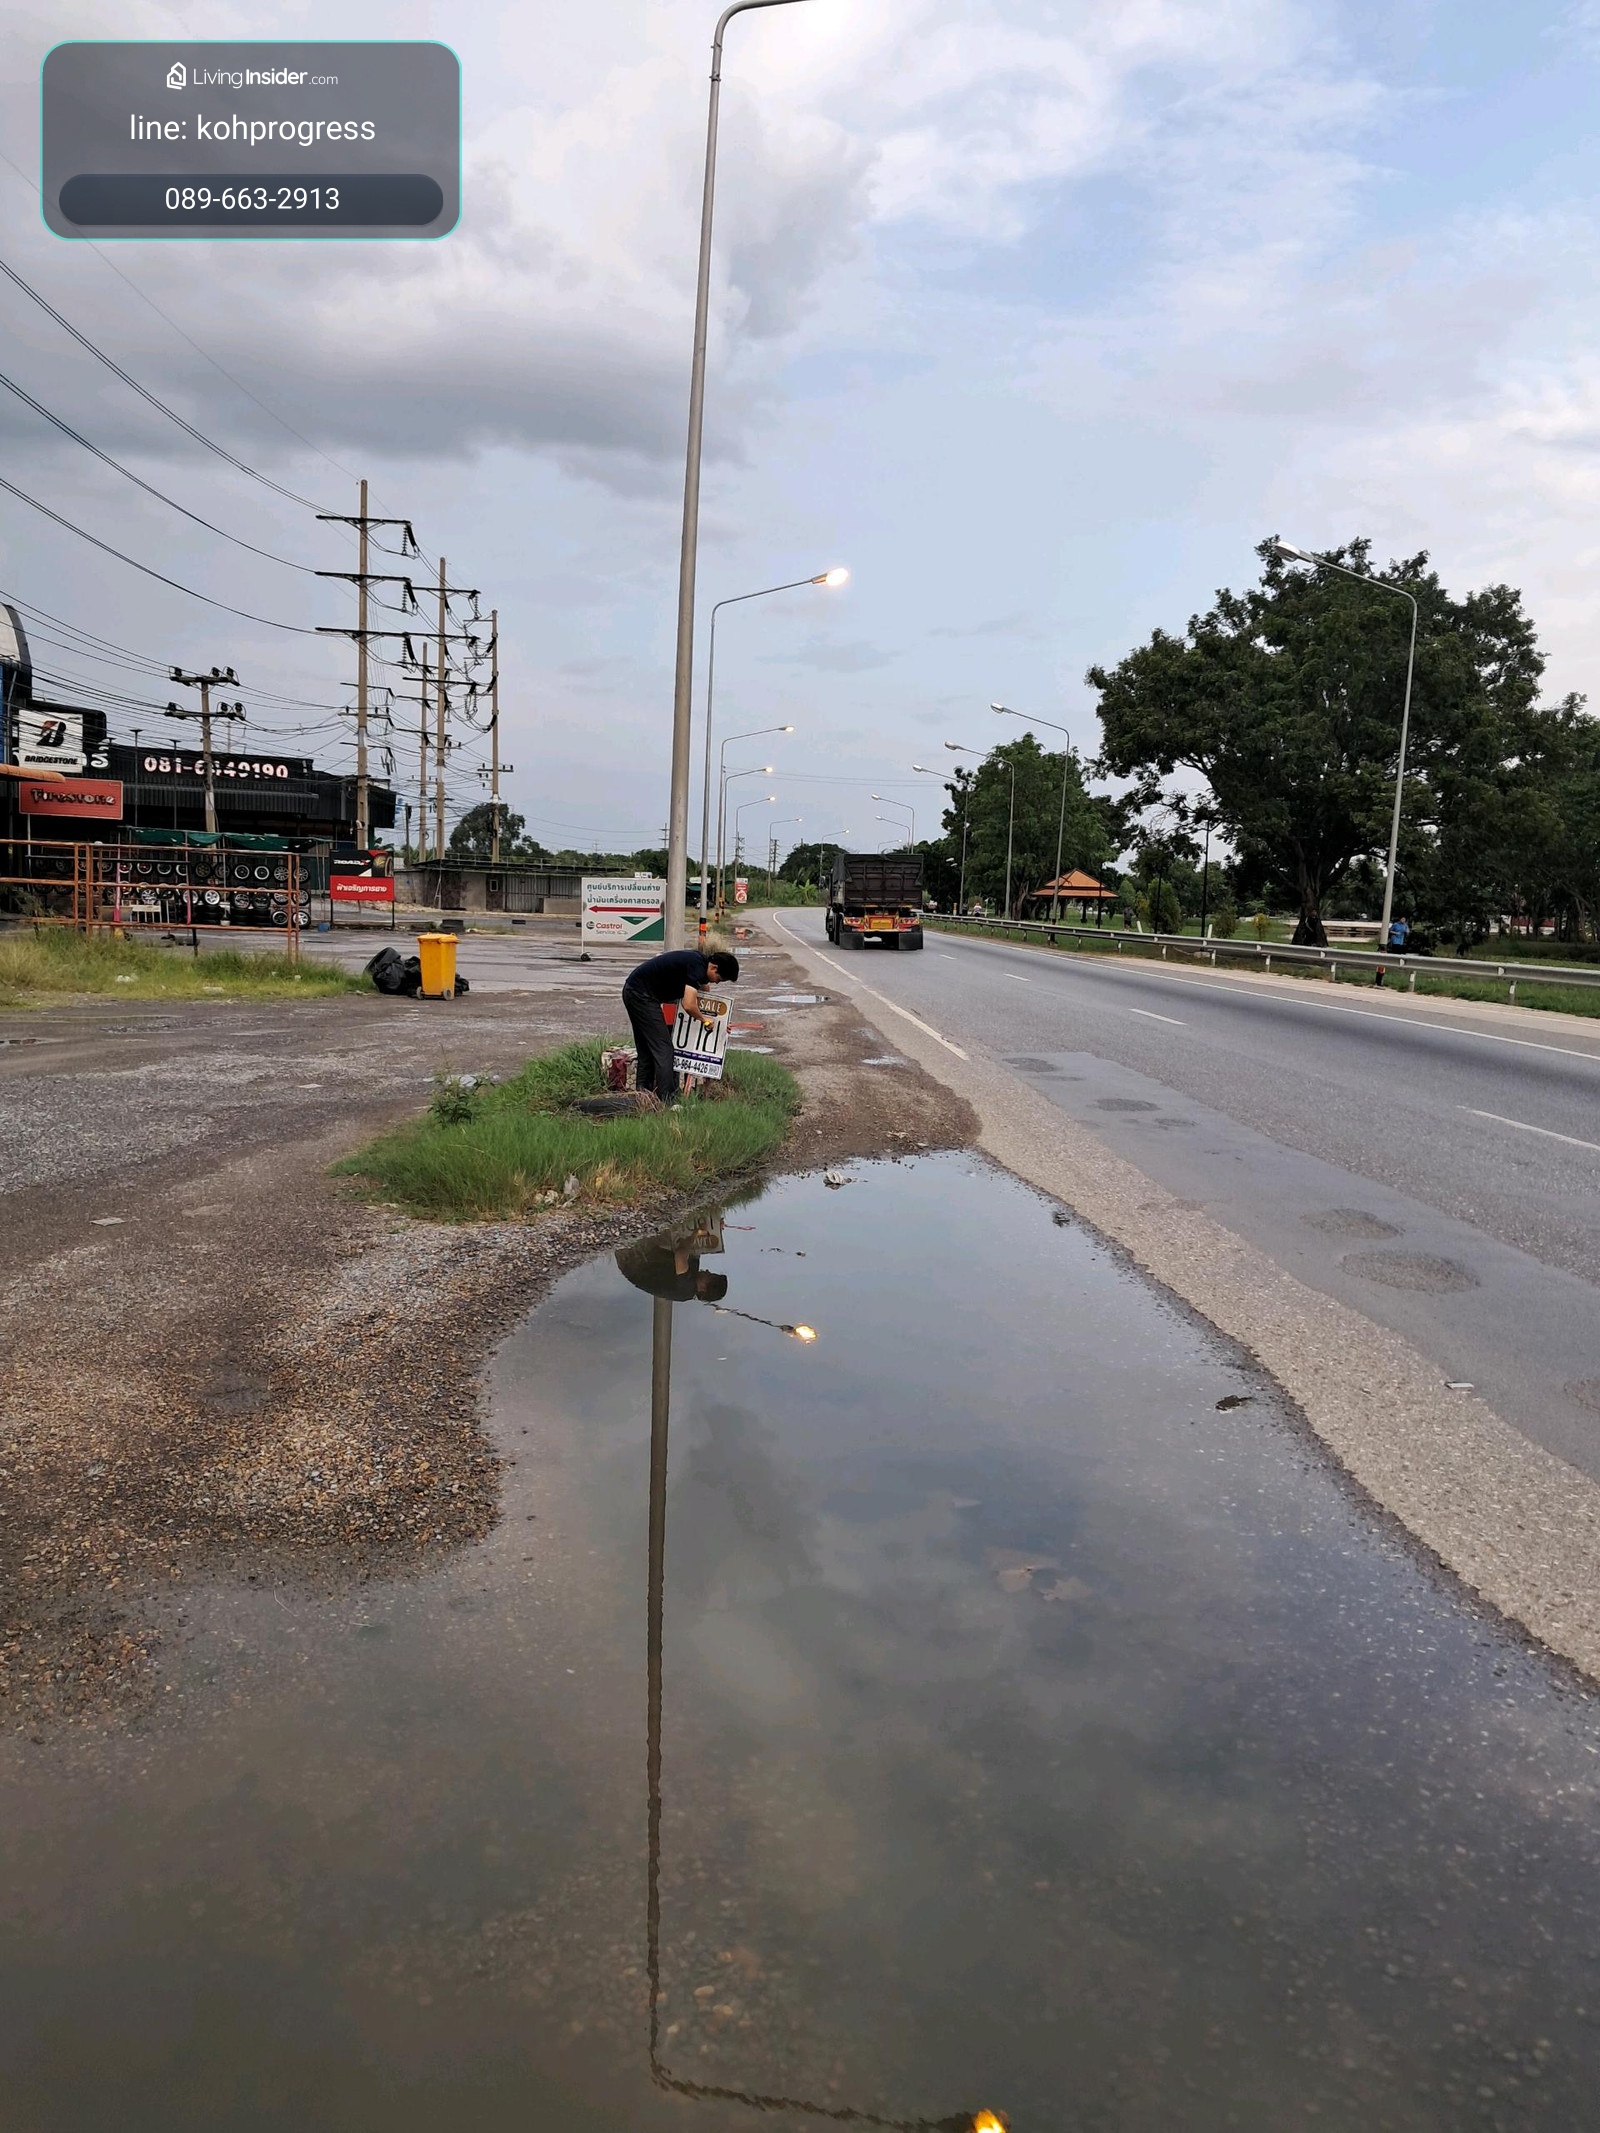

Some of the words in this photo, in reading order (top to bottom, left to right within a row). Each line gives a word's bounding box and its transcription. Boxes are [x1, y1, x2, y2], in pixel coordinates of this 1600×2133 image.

[24, 755, 79, 765] BRIDGESTONE
[31, 787, 116, 806] Firestone
[699, 999, 721, 1013] SALE
